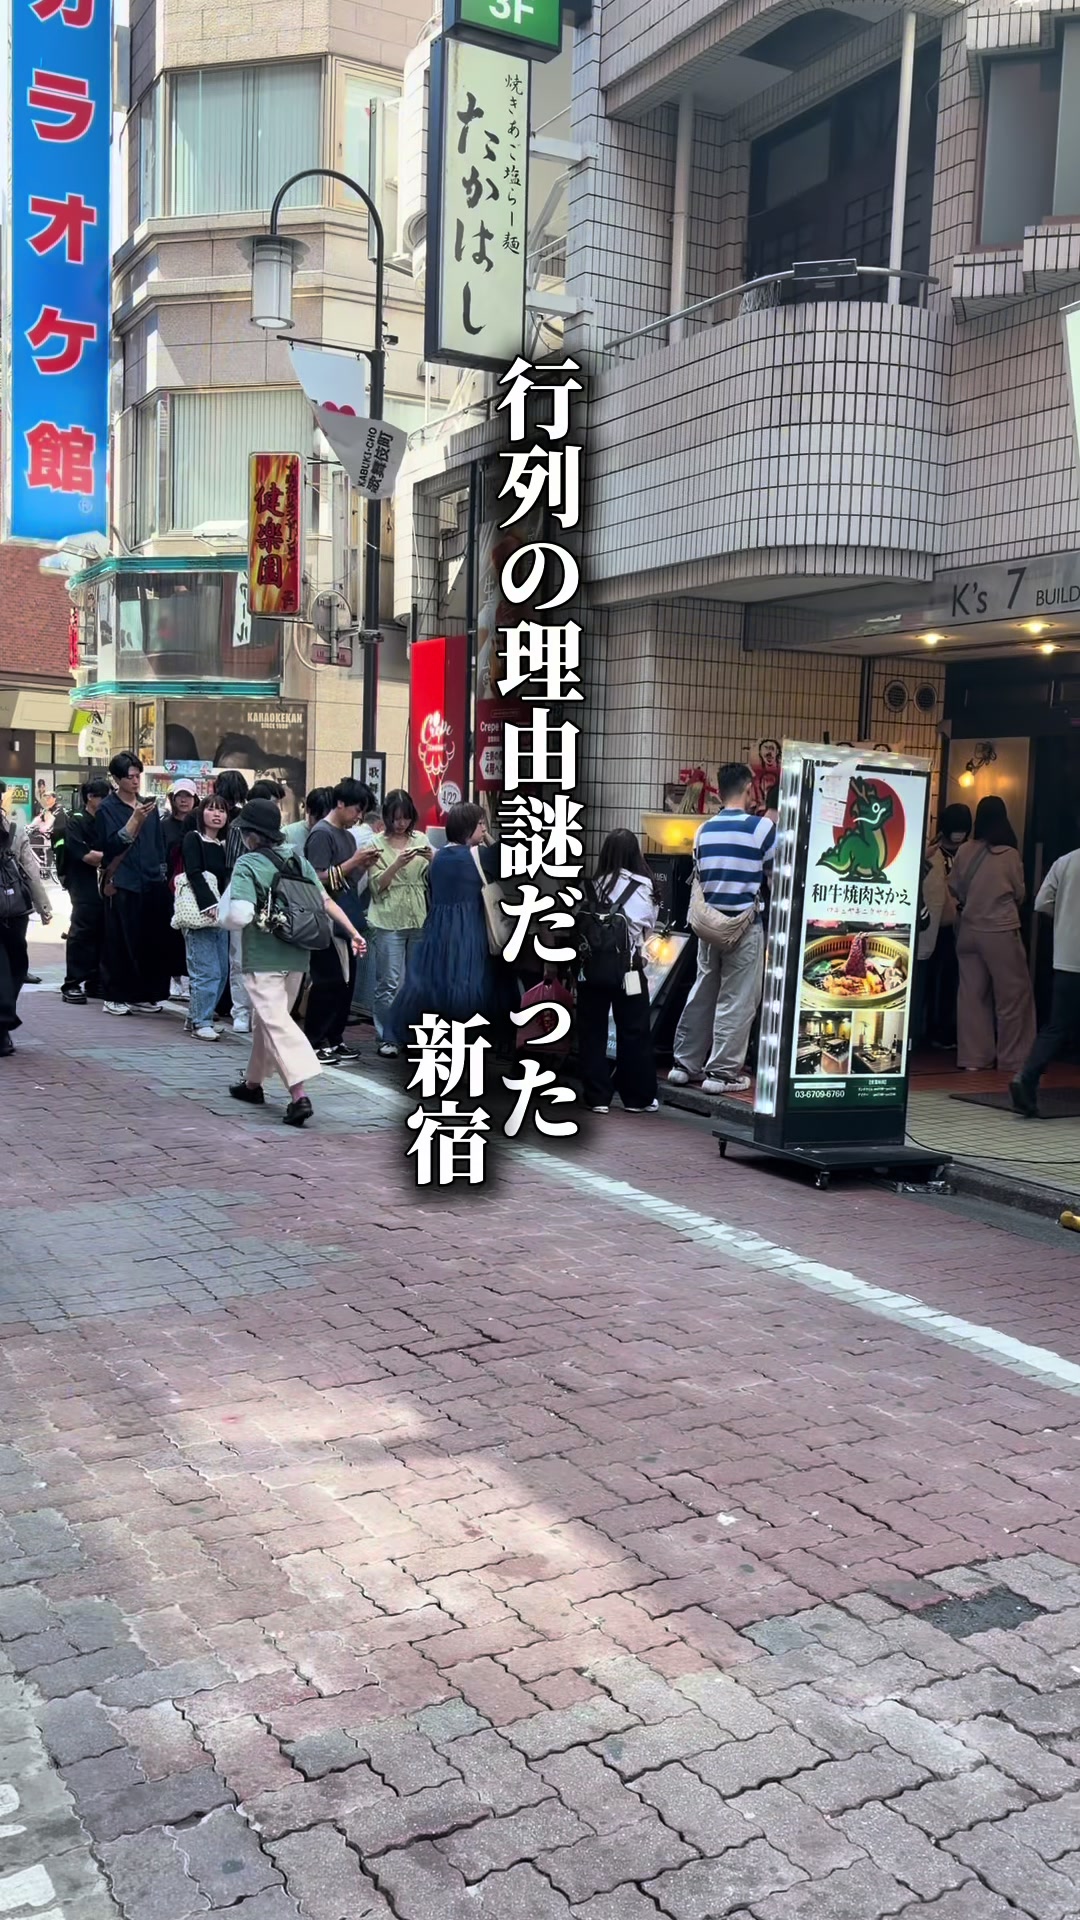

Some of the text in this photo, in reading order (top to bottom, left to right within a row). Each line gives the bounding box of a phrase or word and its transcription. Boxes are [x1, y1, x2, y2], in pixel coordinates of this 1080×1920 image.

[502, 74, 524, 255] 焼きあご塩らー麺
[455, 91, 500, 336] たかはし
[366, 429, 394, 494] 歌舞伎町
[952, 581, 988, 617] K's
[1007, 567, 1027, 609] 7
[247, 712, 302, 724] KARAOKEKAN
[811, 883, 912, 906] 和牛焼肉さかえ
[794, 1090, 846, 1099] 03-6709-6760
